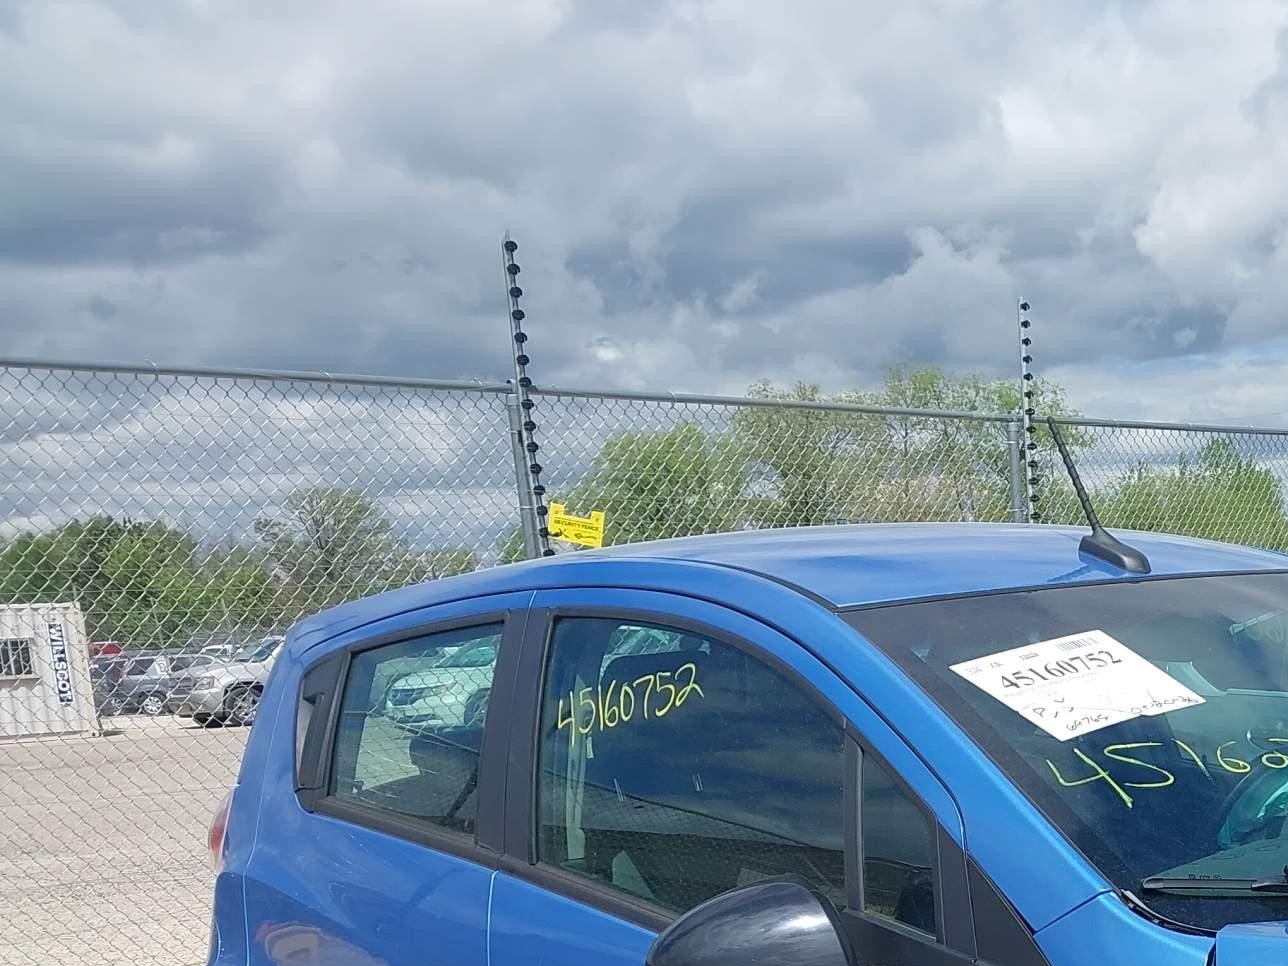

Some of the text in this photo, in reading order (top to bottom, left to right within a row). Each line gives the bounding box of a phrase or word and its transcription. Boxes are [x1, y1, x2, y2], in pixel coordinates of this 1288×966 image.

[554, 519, 581, 528] SECURITY
[49, 625, 72, 702] WILLSCOT
[1002, 651, 1122, 688] 45160752
[557, 662, 704, 747] 45160752
